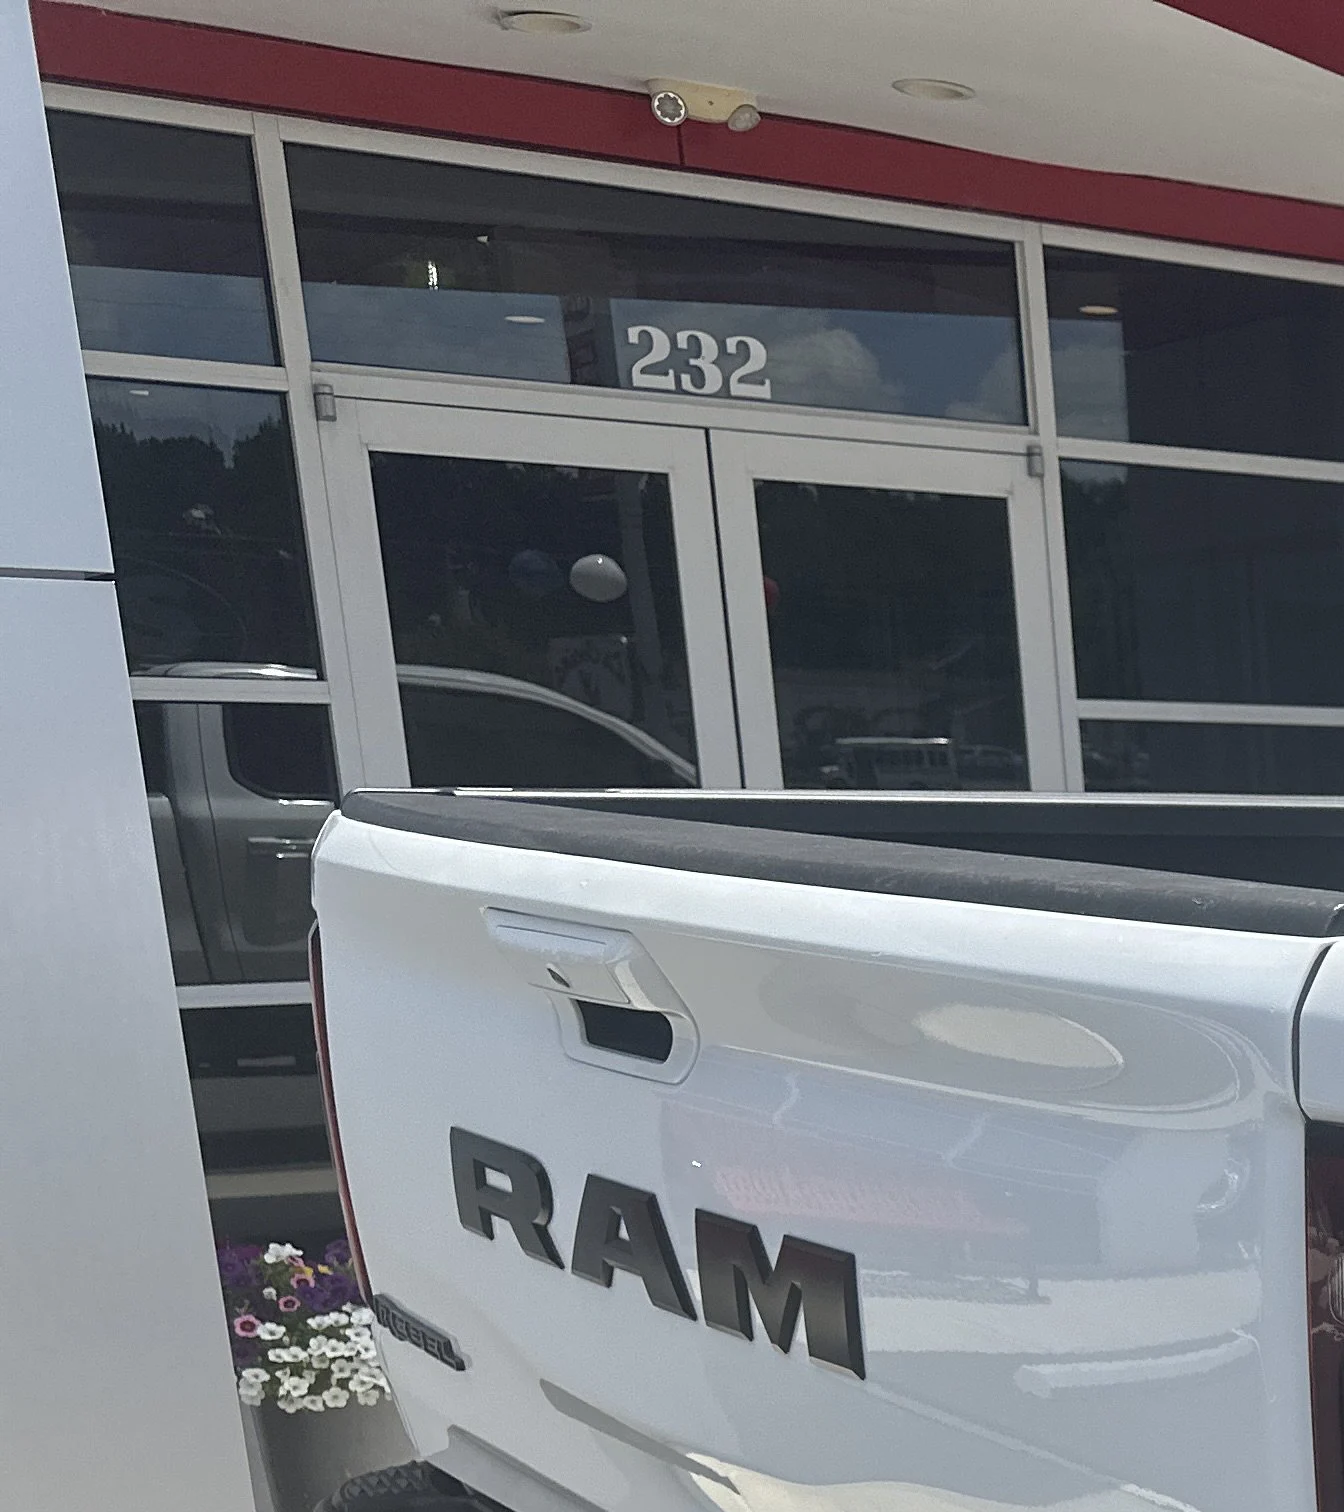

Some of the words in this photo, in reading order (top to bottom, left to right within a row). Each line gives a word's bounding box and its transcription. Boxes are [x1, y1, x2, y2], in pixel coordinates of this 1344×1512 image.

[627, 325, 772, 399] 232
[450, 1126, 866, 1381] RAM
[373, 1293, 466, 1371] REBEL
